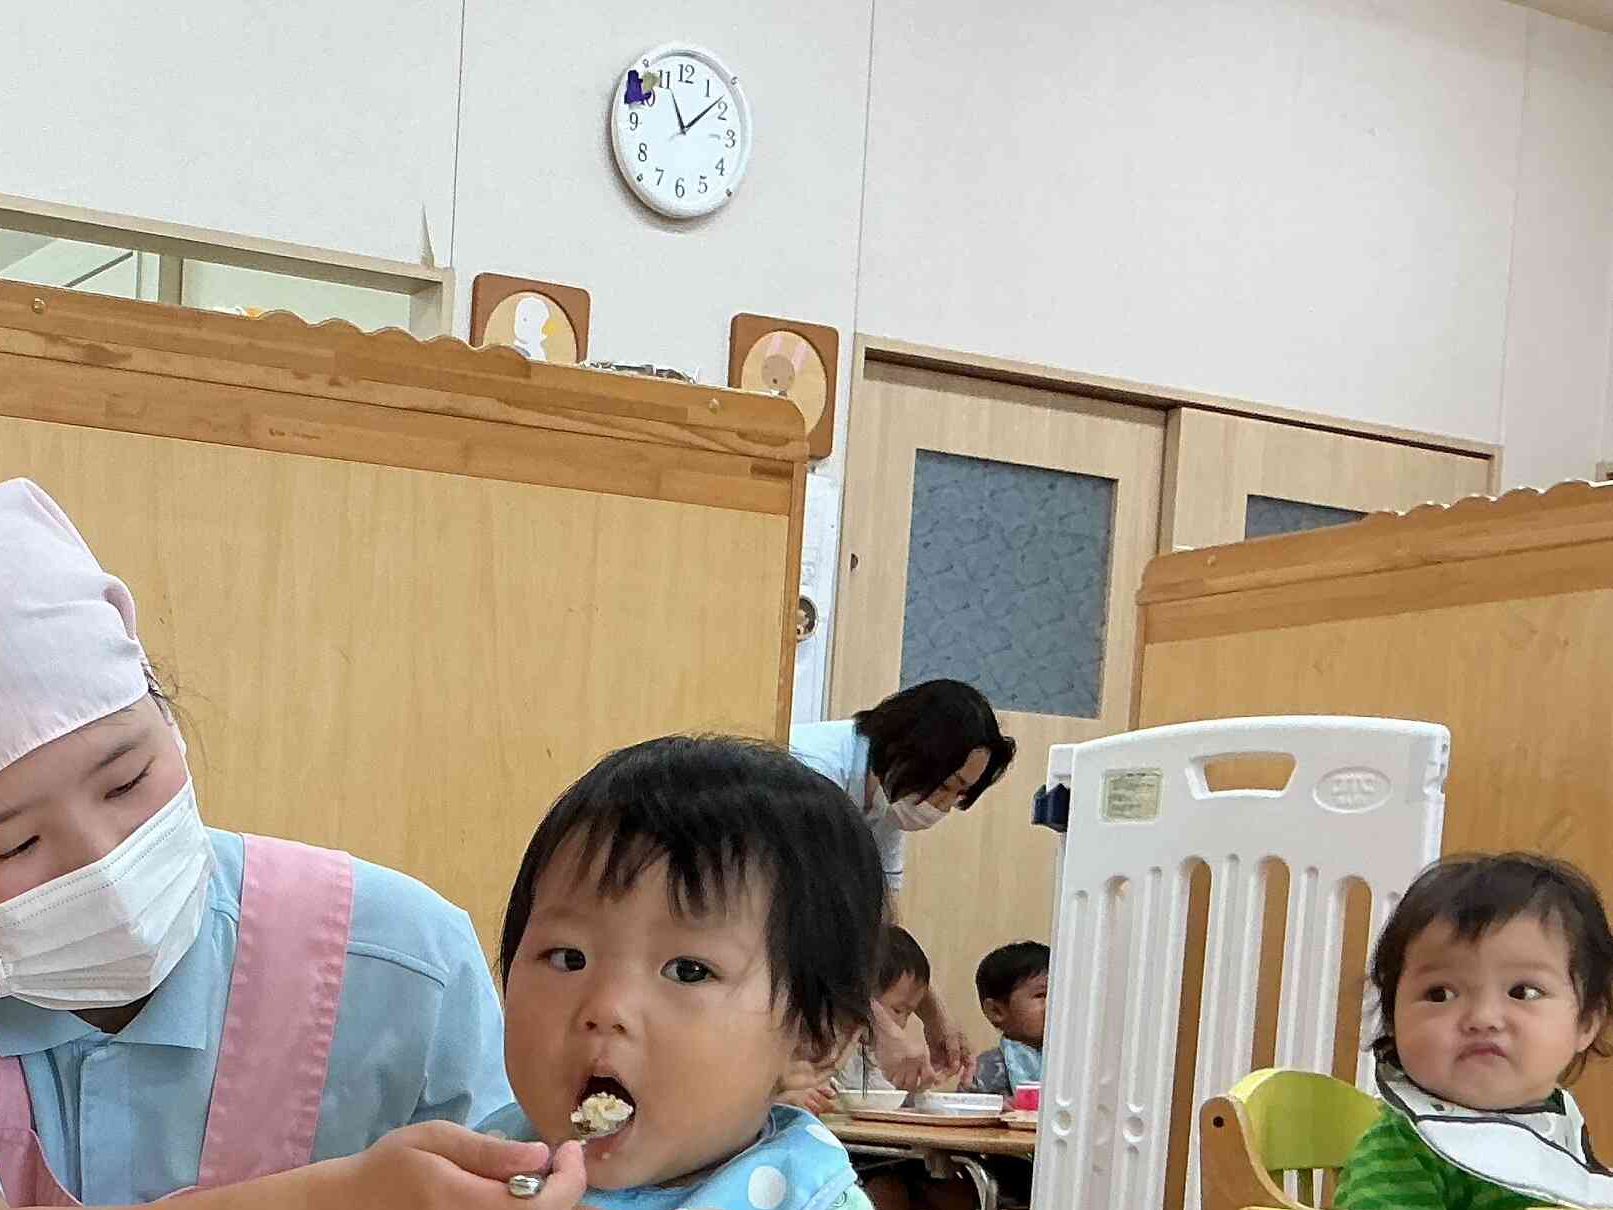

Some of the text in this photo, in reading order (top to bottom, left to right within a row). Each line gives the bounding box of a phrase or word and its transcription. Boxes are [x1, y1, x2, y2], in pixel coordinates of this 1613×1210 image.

[658, 69, 671, 89] 11
[678, 64, 695, 84] 12
[705, 79, 710, 97] 1
[718, 101, 728, 121] 2
[629, 112, 638, 131] 9
[725, 129, 736, 149] 3
[638, 142, 648, 162] 8
[655, 167, 664, 186] 7
[715, 157, 725, 176] 4
[675, 177, 685, 199] 6
[697, 175, 708, 194] 5
